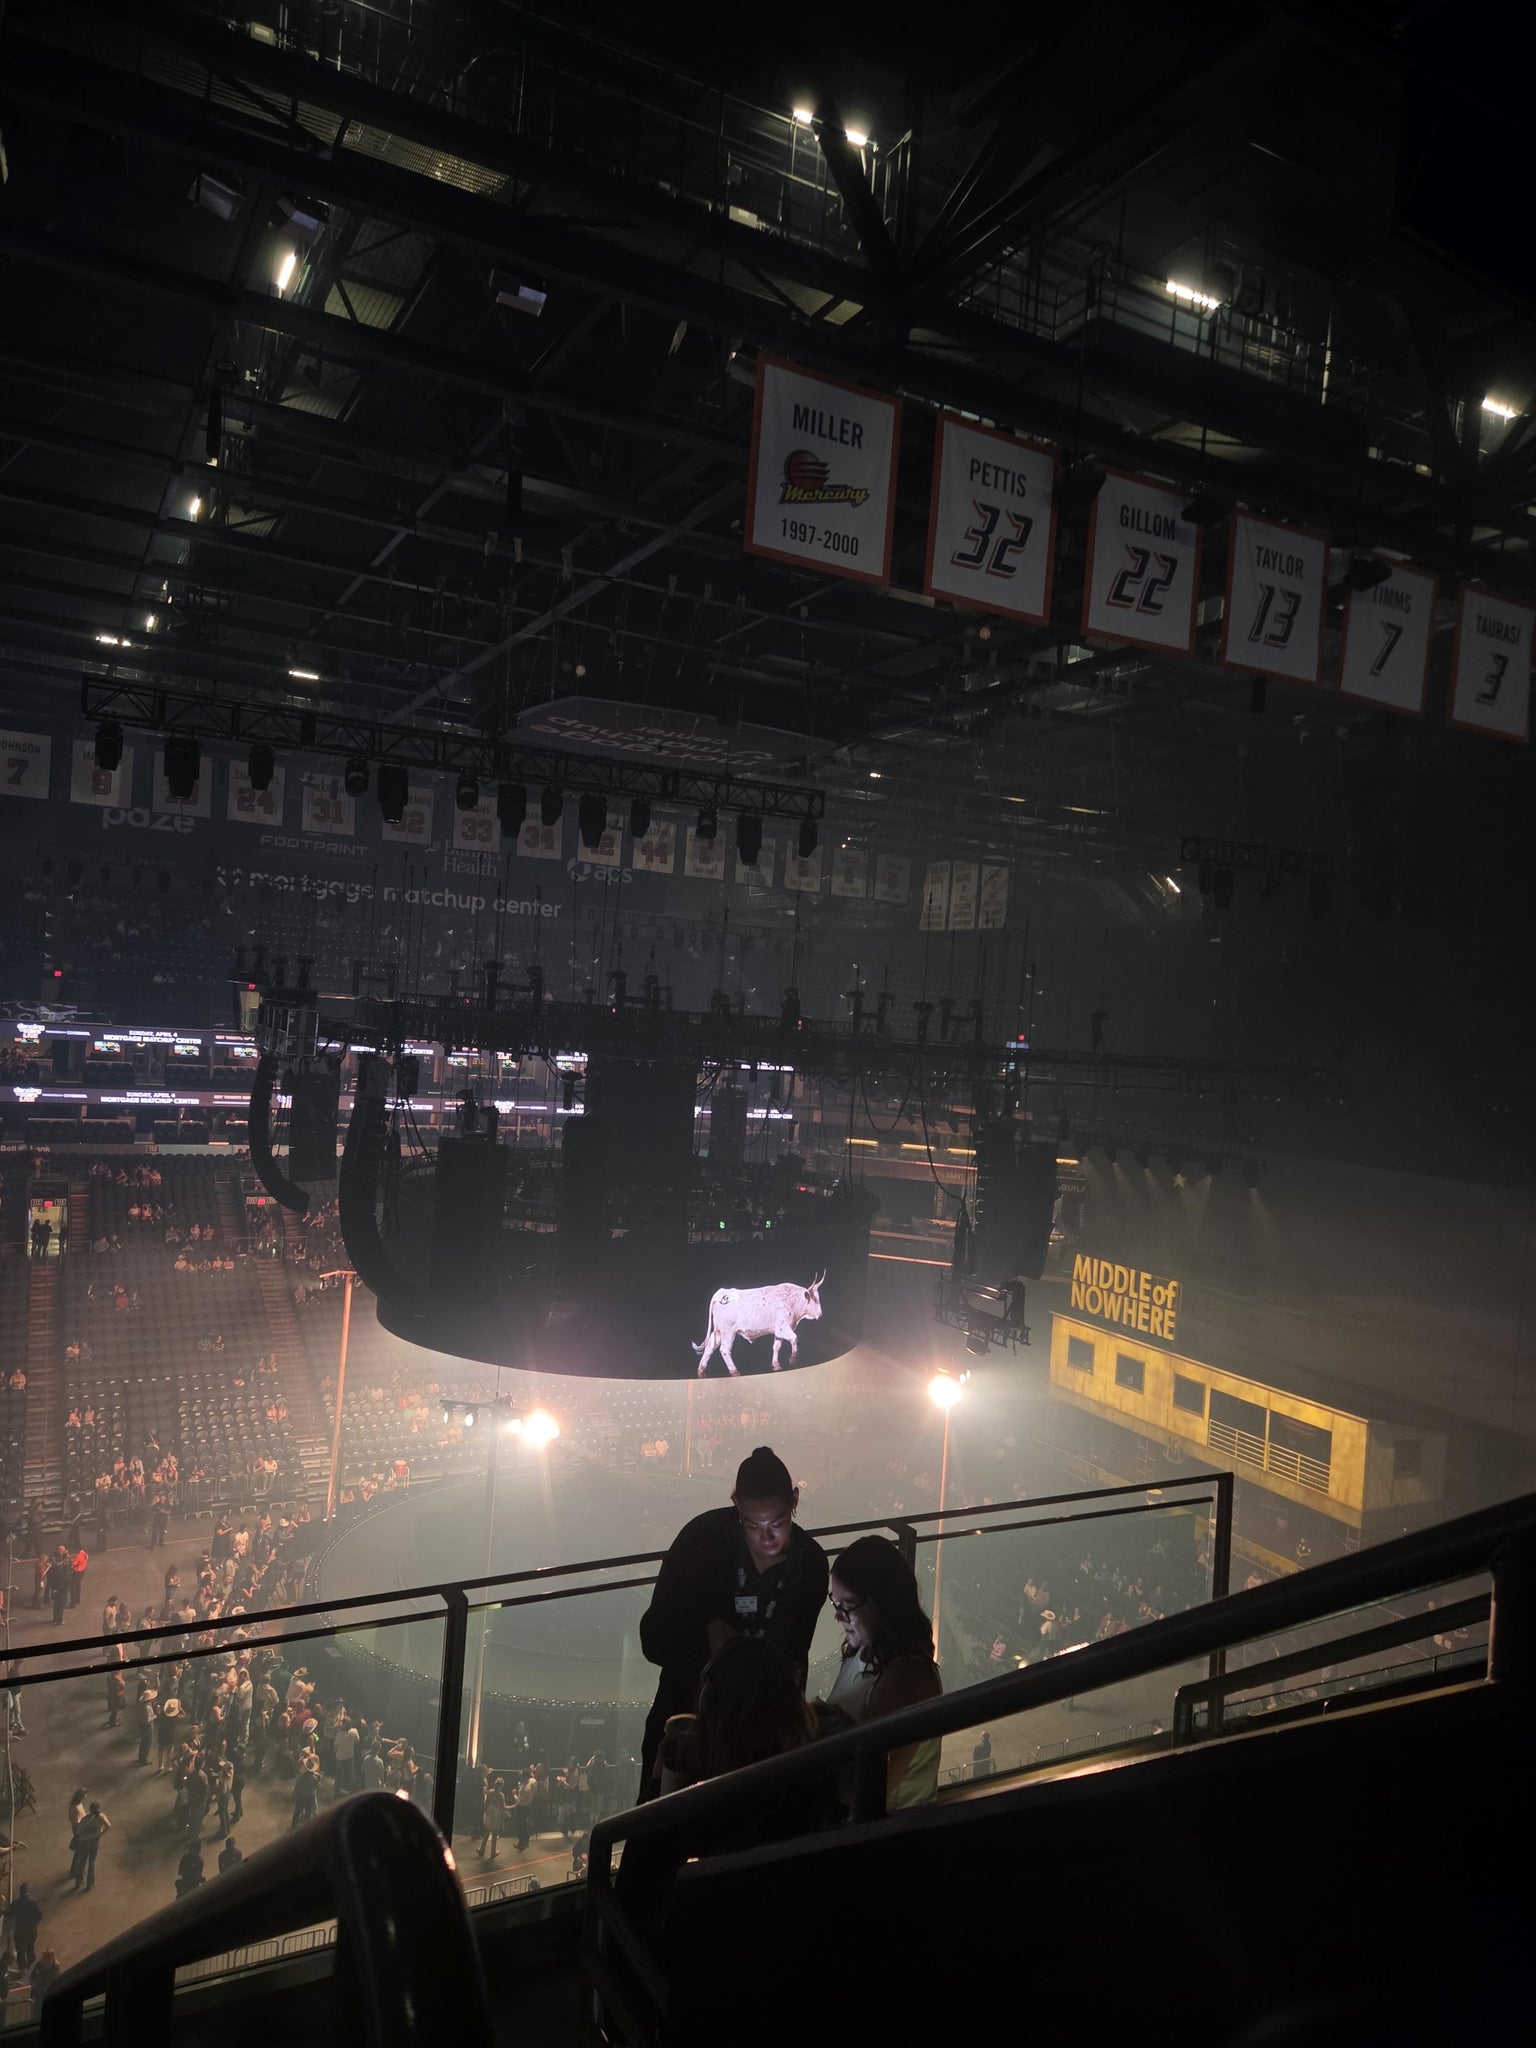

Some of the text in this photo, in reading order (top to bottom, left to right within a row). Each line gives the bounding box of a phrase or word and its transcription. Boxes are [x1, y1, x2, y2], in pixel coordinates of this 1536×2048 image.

[792, 403, 864, 450] MILLER
[969, 458, 1027, 498] PETTIS
[779, 483, 869, 508] Mercury
[781, 517, 859, 556] 1997-2000
[1120, 505, 1176, 540] GILLOM
[951, 499, 1033, 579] 32
[1256, 546, 1304, 579] TAYLOR
[1105, 543, 1178, 616] 22
[1248, 582, 1302, 649] 13
[1476, 614, 1521, 646] TAURASI
[1370, 620, 1403, 677] 7
[1475, 651, 1509, 706] 3
[7, 758, 28, 785] 7
[91, 768, 113, 796] 9
[237, 787, 274, 815] 24
[313, 798, 344, 824] 31
[101, 808, 196, 834] paze
[461, 817, 493, 843] 33
[260, 834, 369, 857] FOOTPRINT
[524, 825, 555, 850] 34
[443, 855, 498, 878] Health
[641, 840, 668, 865] 44
[594, 864, 633, 886] aps
[492, 897, 563, 919] center
[103, 1034, 142, 1042] MORTGAGE
[175, 1037, 202, 1045] CENTER
[1072, 1253, 1180, 1310] MIDDLE of
[1070, 1281, 1177, 1341] NOWHERE
